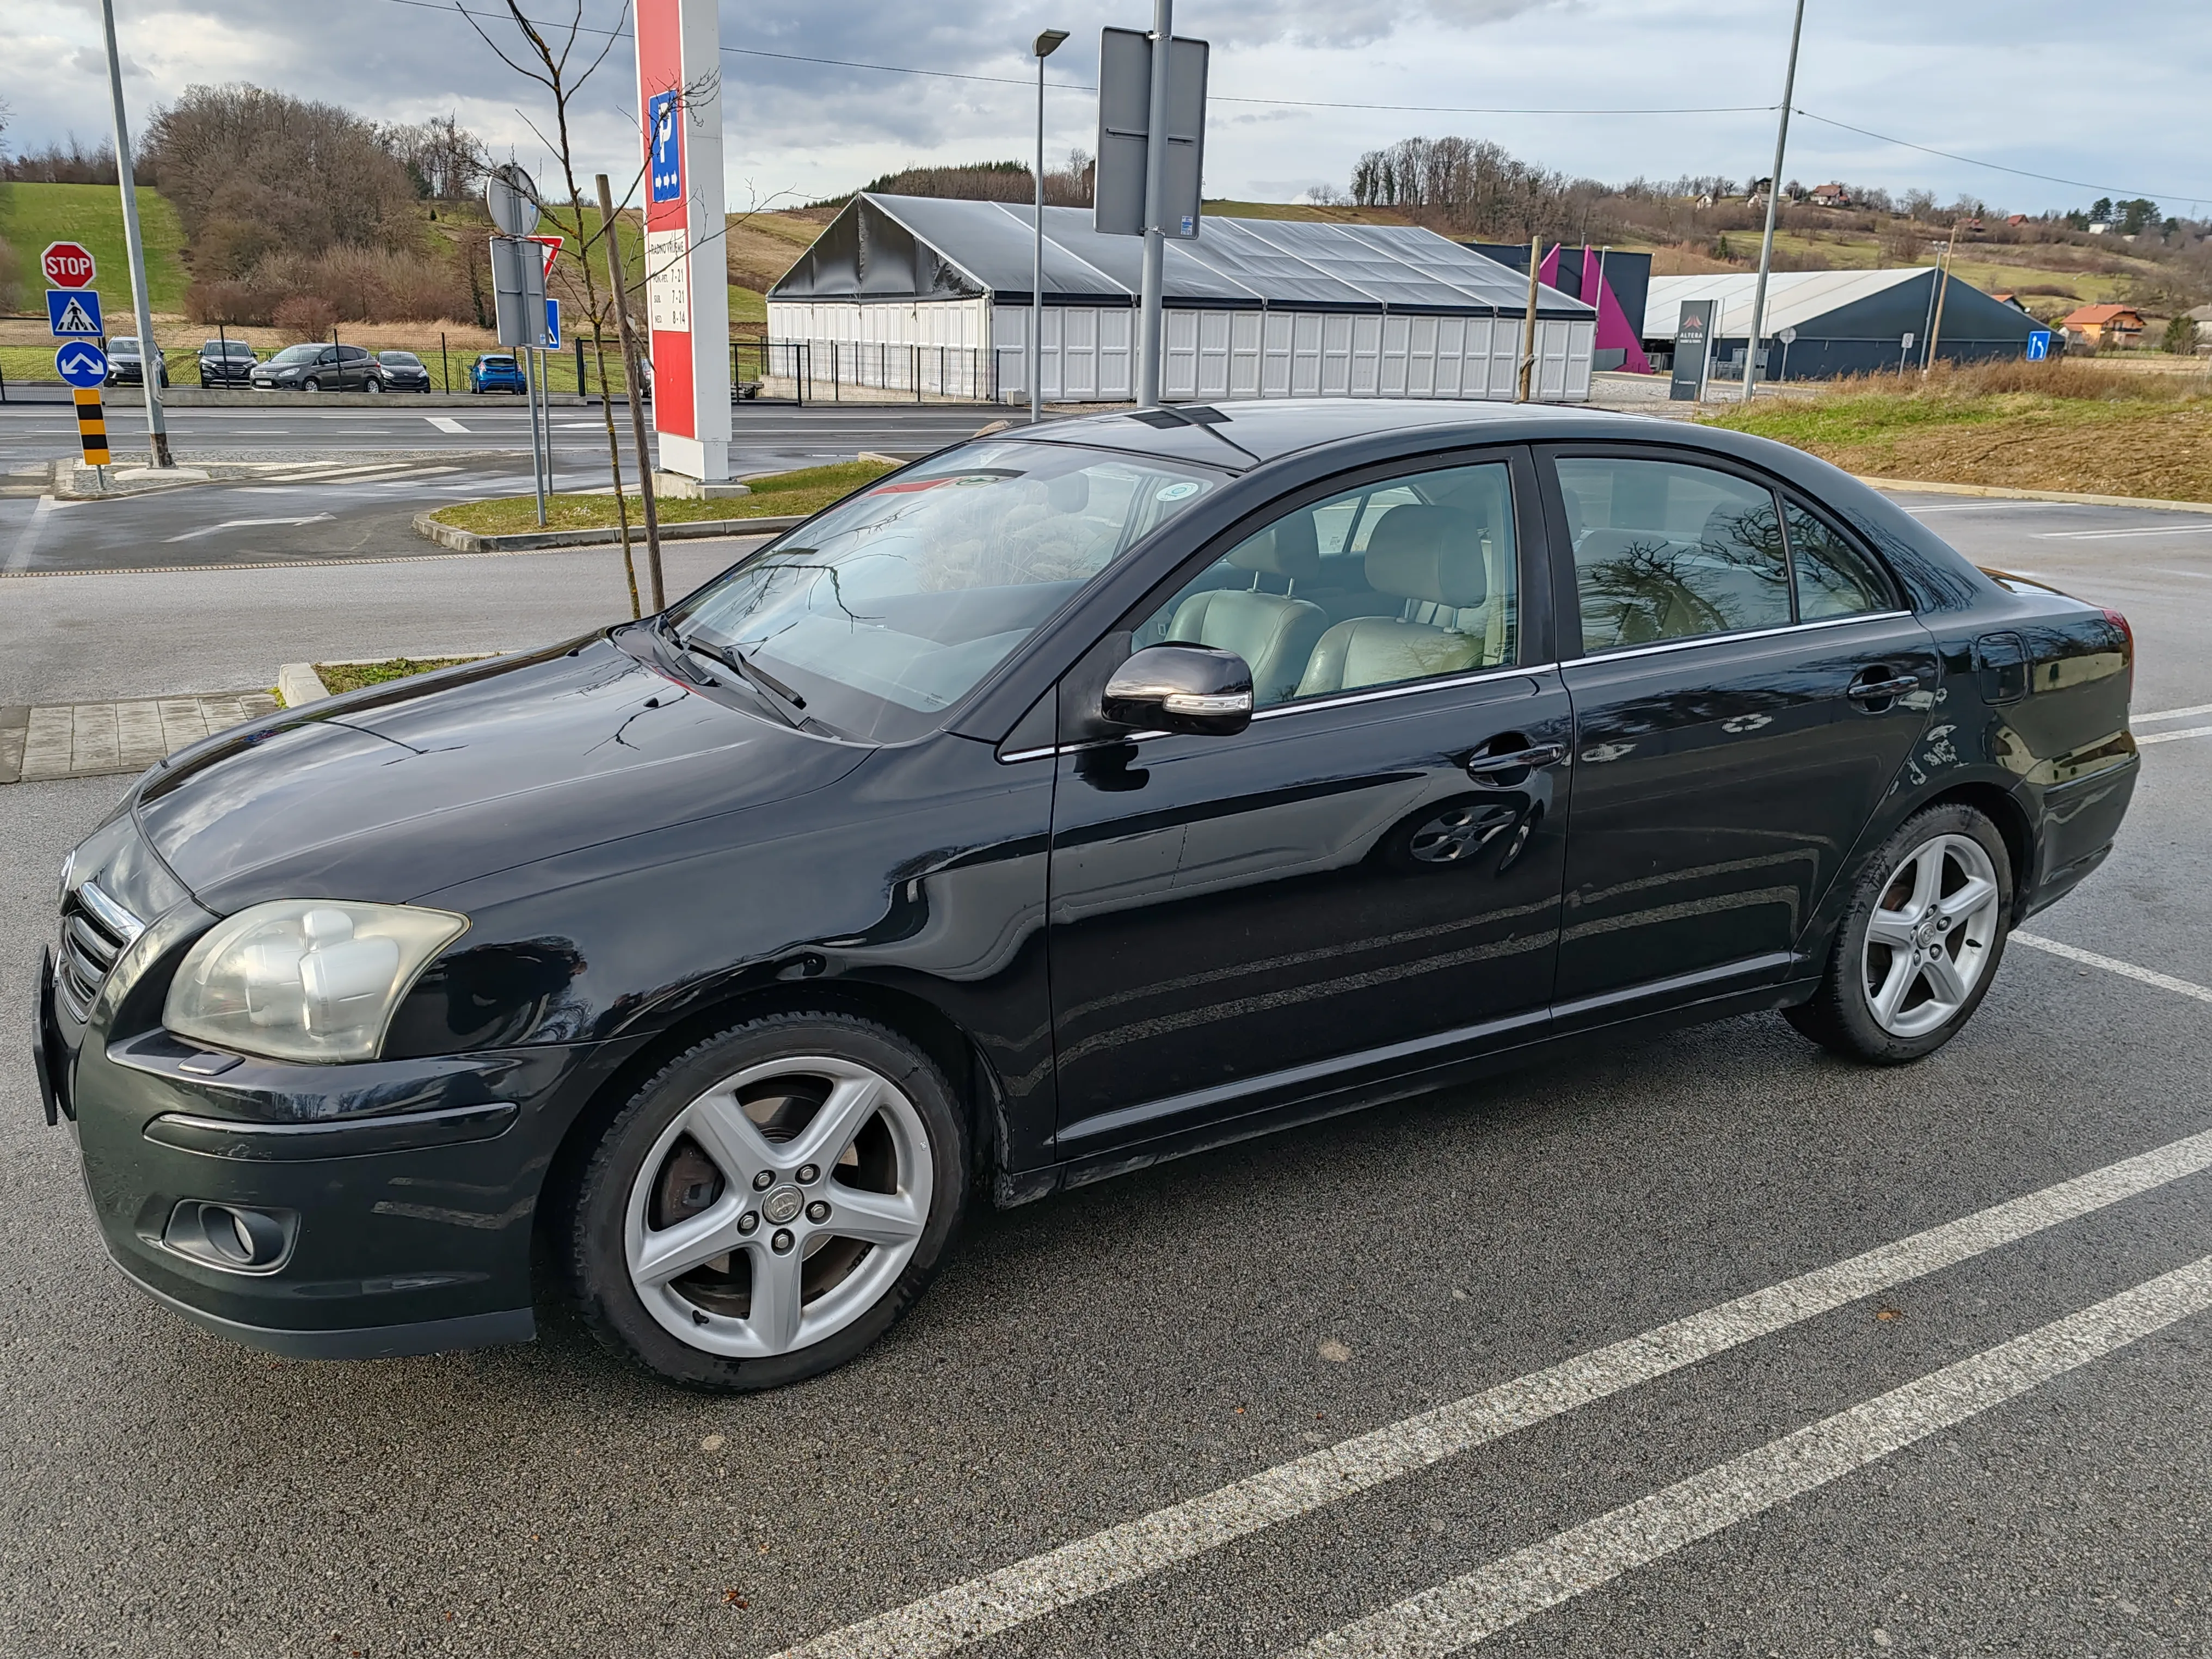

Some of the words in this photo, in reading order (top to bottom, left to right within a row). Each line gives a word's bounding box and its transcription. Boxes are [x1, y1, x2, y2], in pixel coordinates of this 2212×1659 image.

[658, 102, 671, 163] P
[651, 243, 666, 254] RADNO
[667, 241, 684, 253] VRIJEME
[47, 256, 90, 275] STOP
